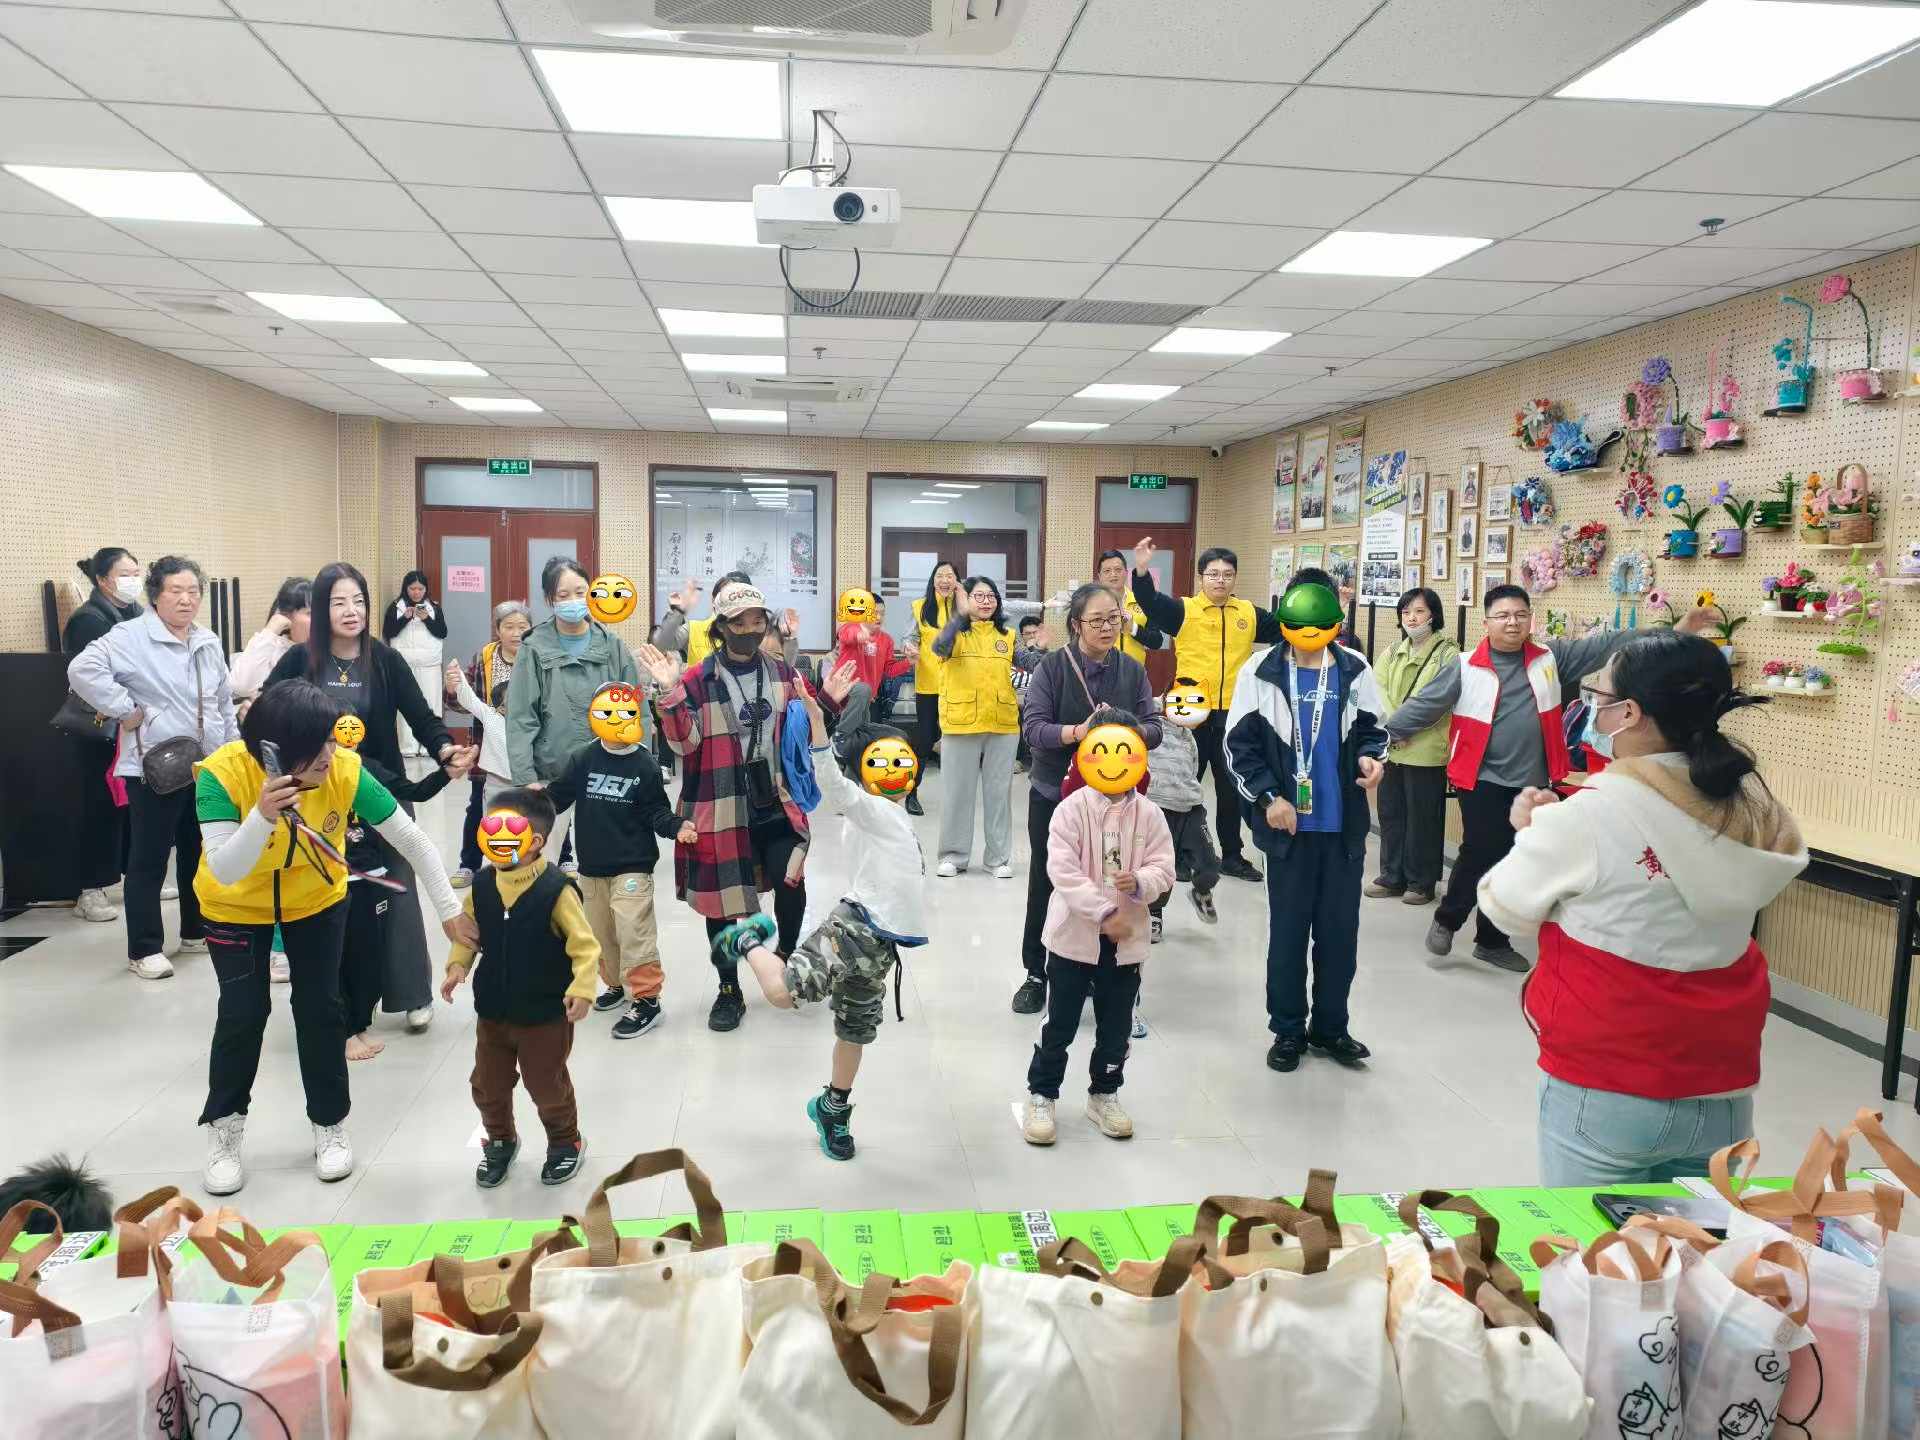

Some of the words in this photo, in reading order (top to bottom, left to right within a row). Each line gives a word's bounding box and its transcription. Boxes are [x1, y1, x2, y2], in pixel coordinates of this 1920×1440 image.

[491, 460, 527, 470] 安全出口
[1132, 475, 1164, 485] 安全出口
